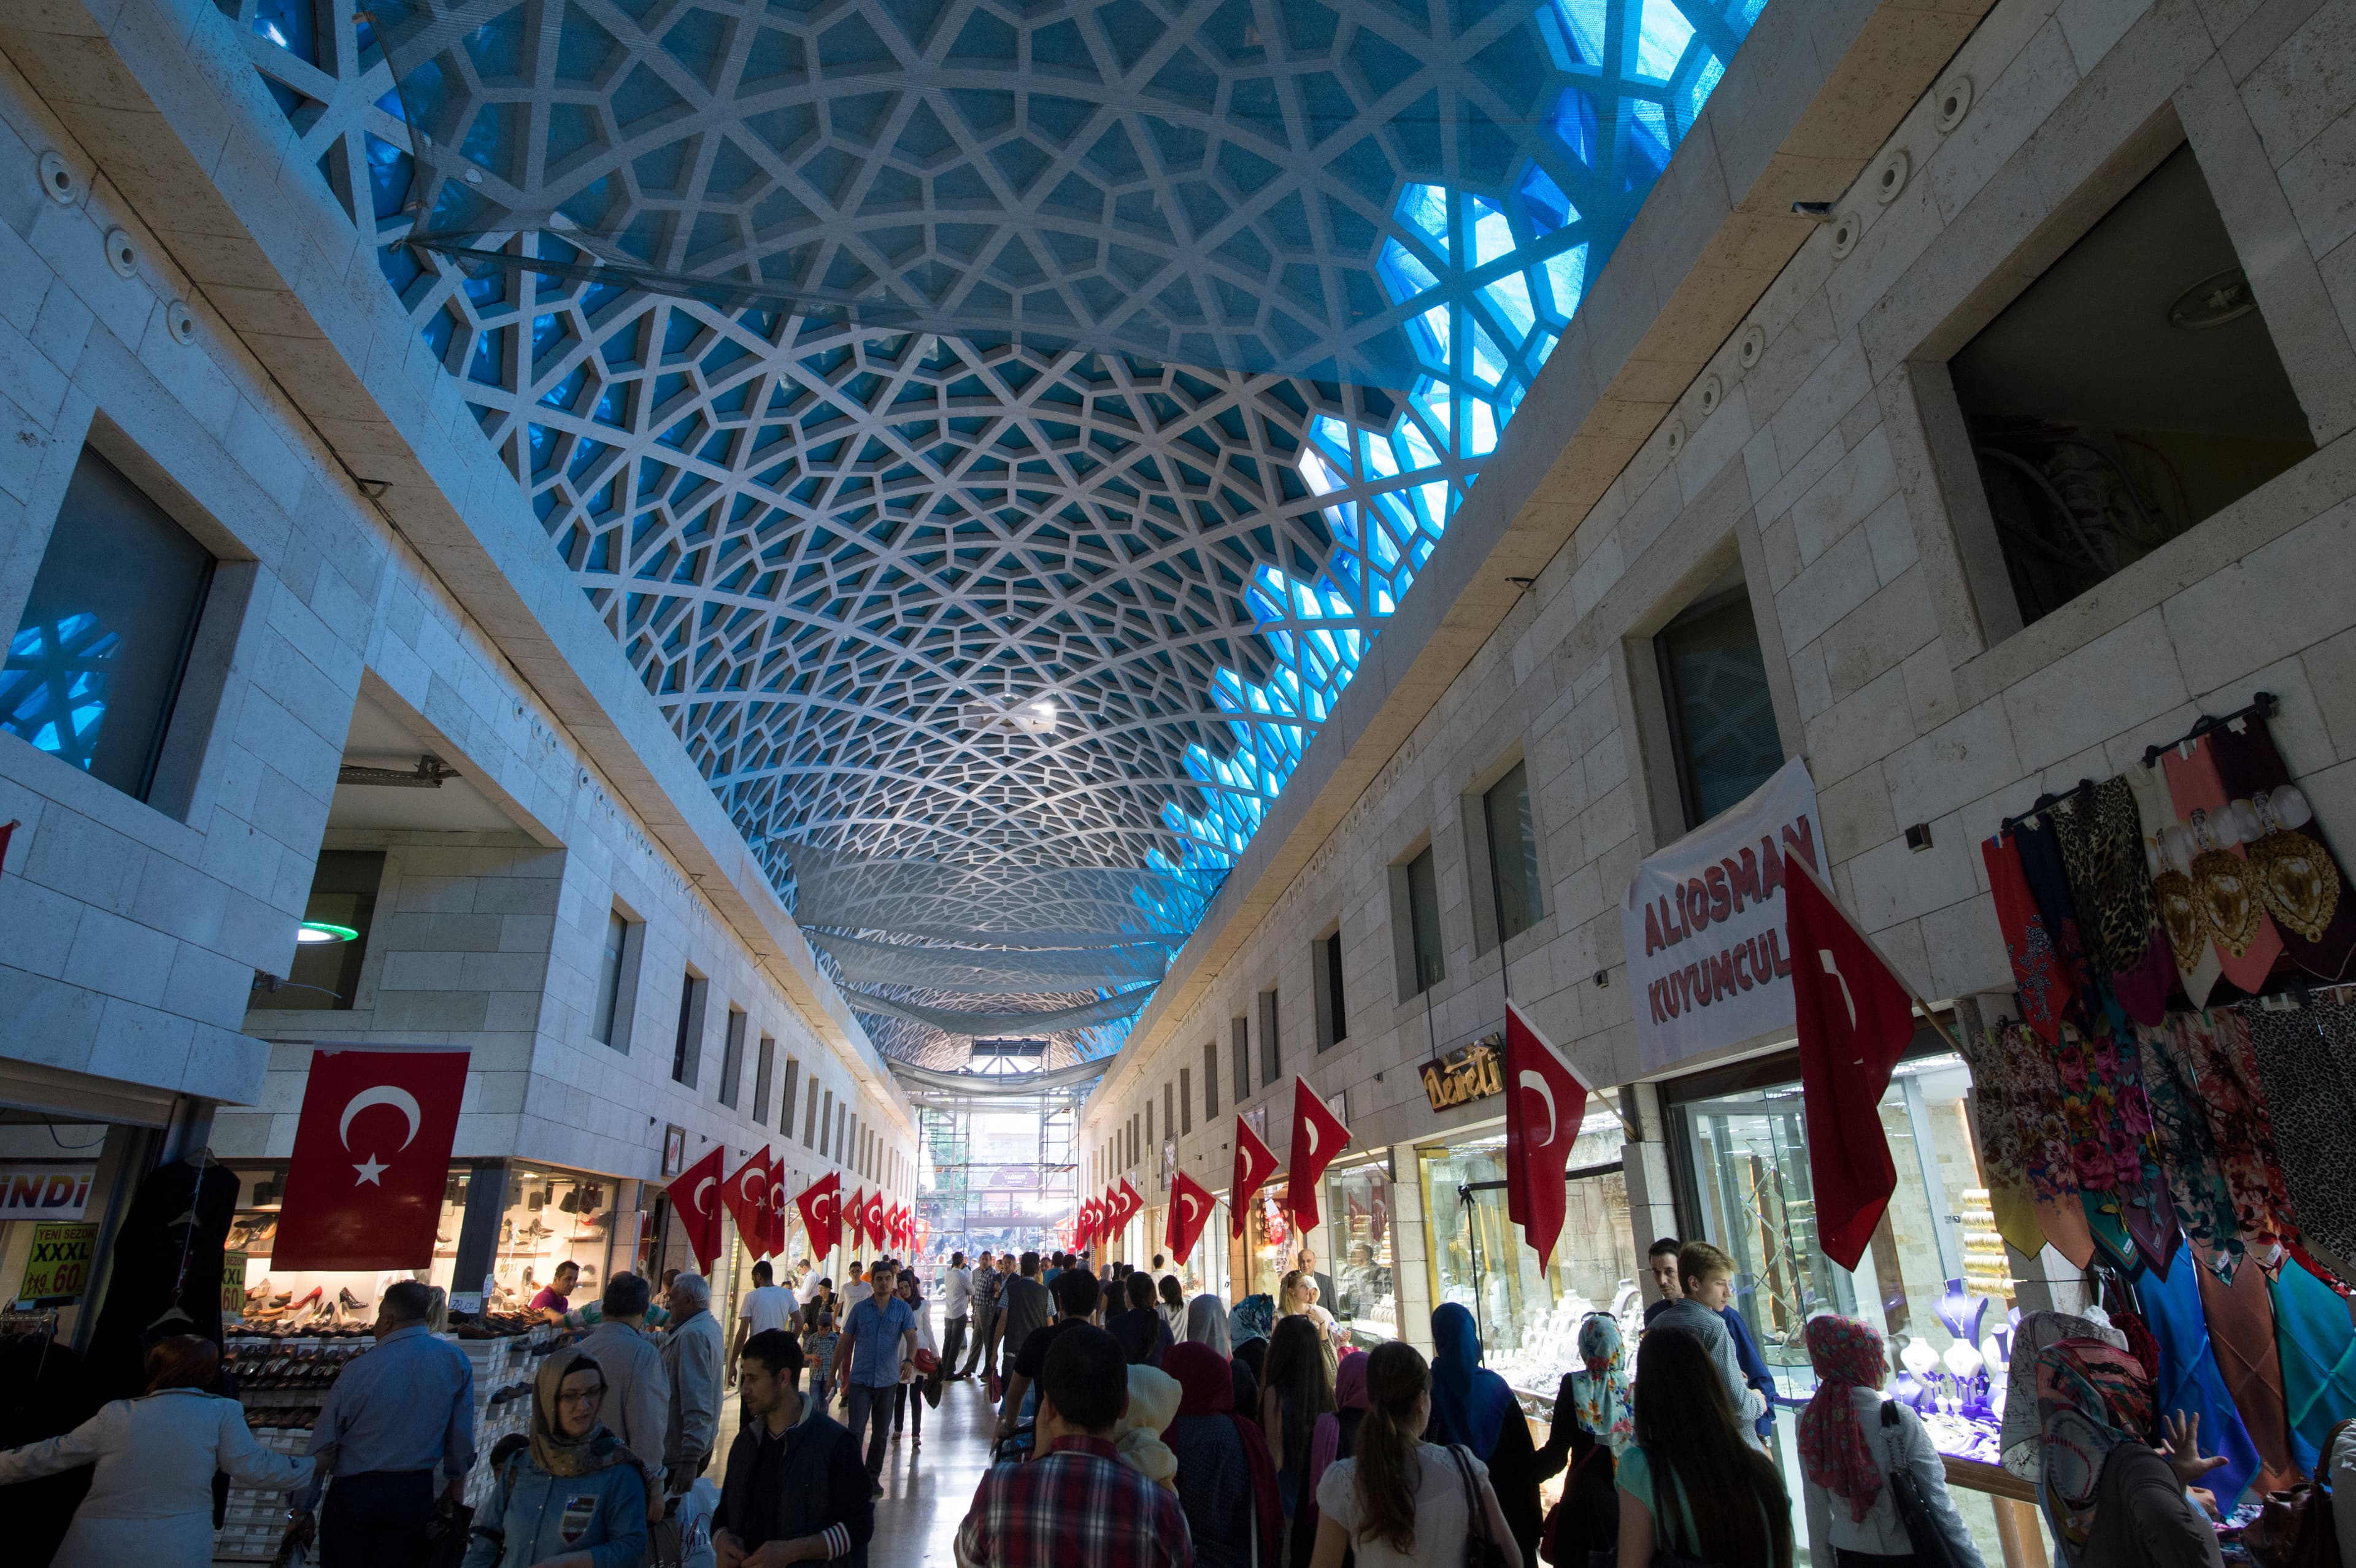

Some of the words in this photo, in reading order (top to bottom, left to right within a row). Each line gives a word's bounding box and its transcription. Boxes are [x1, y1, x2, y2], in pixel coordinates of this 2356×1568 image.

[1648, 923, 1792, 1026] KUYUMCUL
[1423, 1042, 1503, 1109] Dereli
[64, 1228, 96, 1240] SEZON
[33, 1242, 90, 1262] XXXL
[226, 1256, 246, 1266] SEZON
[53, 1264, 80, 1293] 60
[223, 1287, 239, 1312] 60
